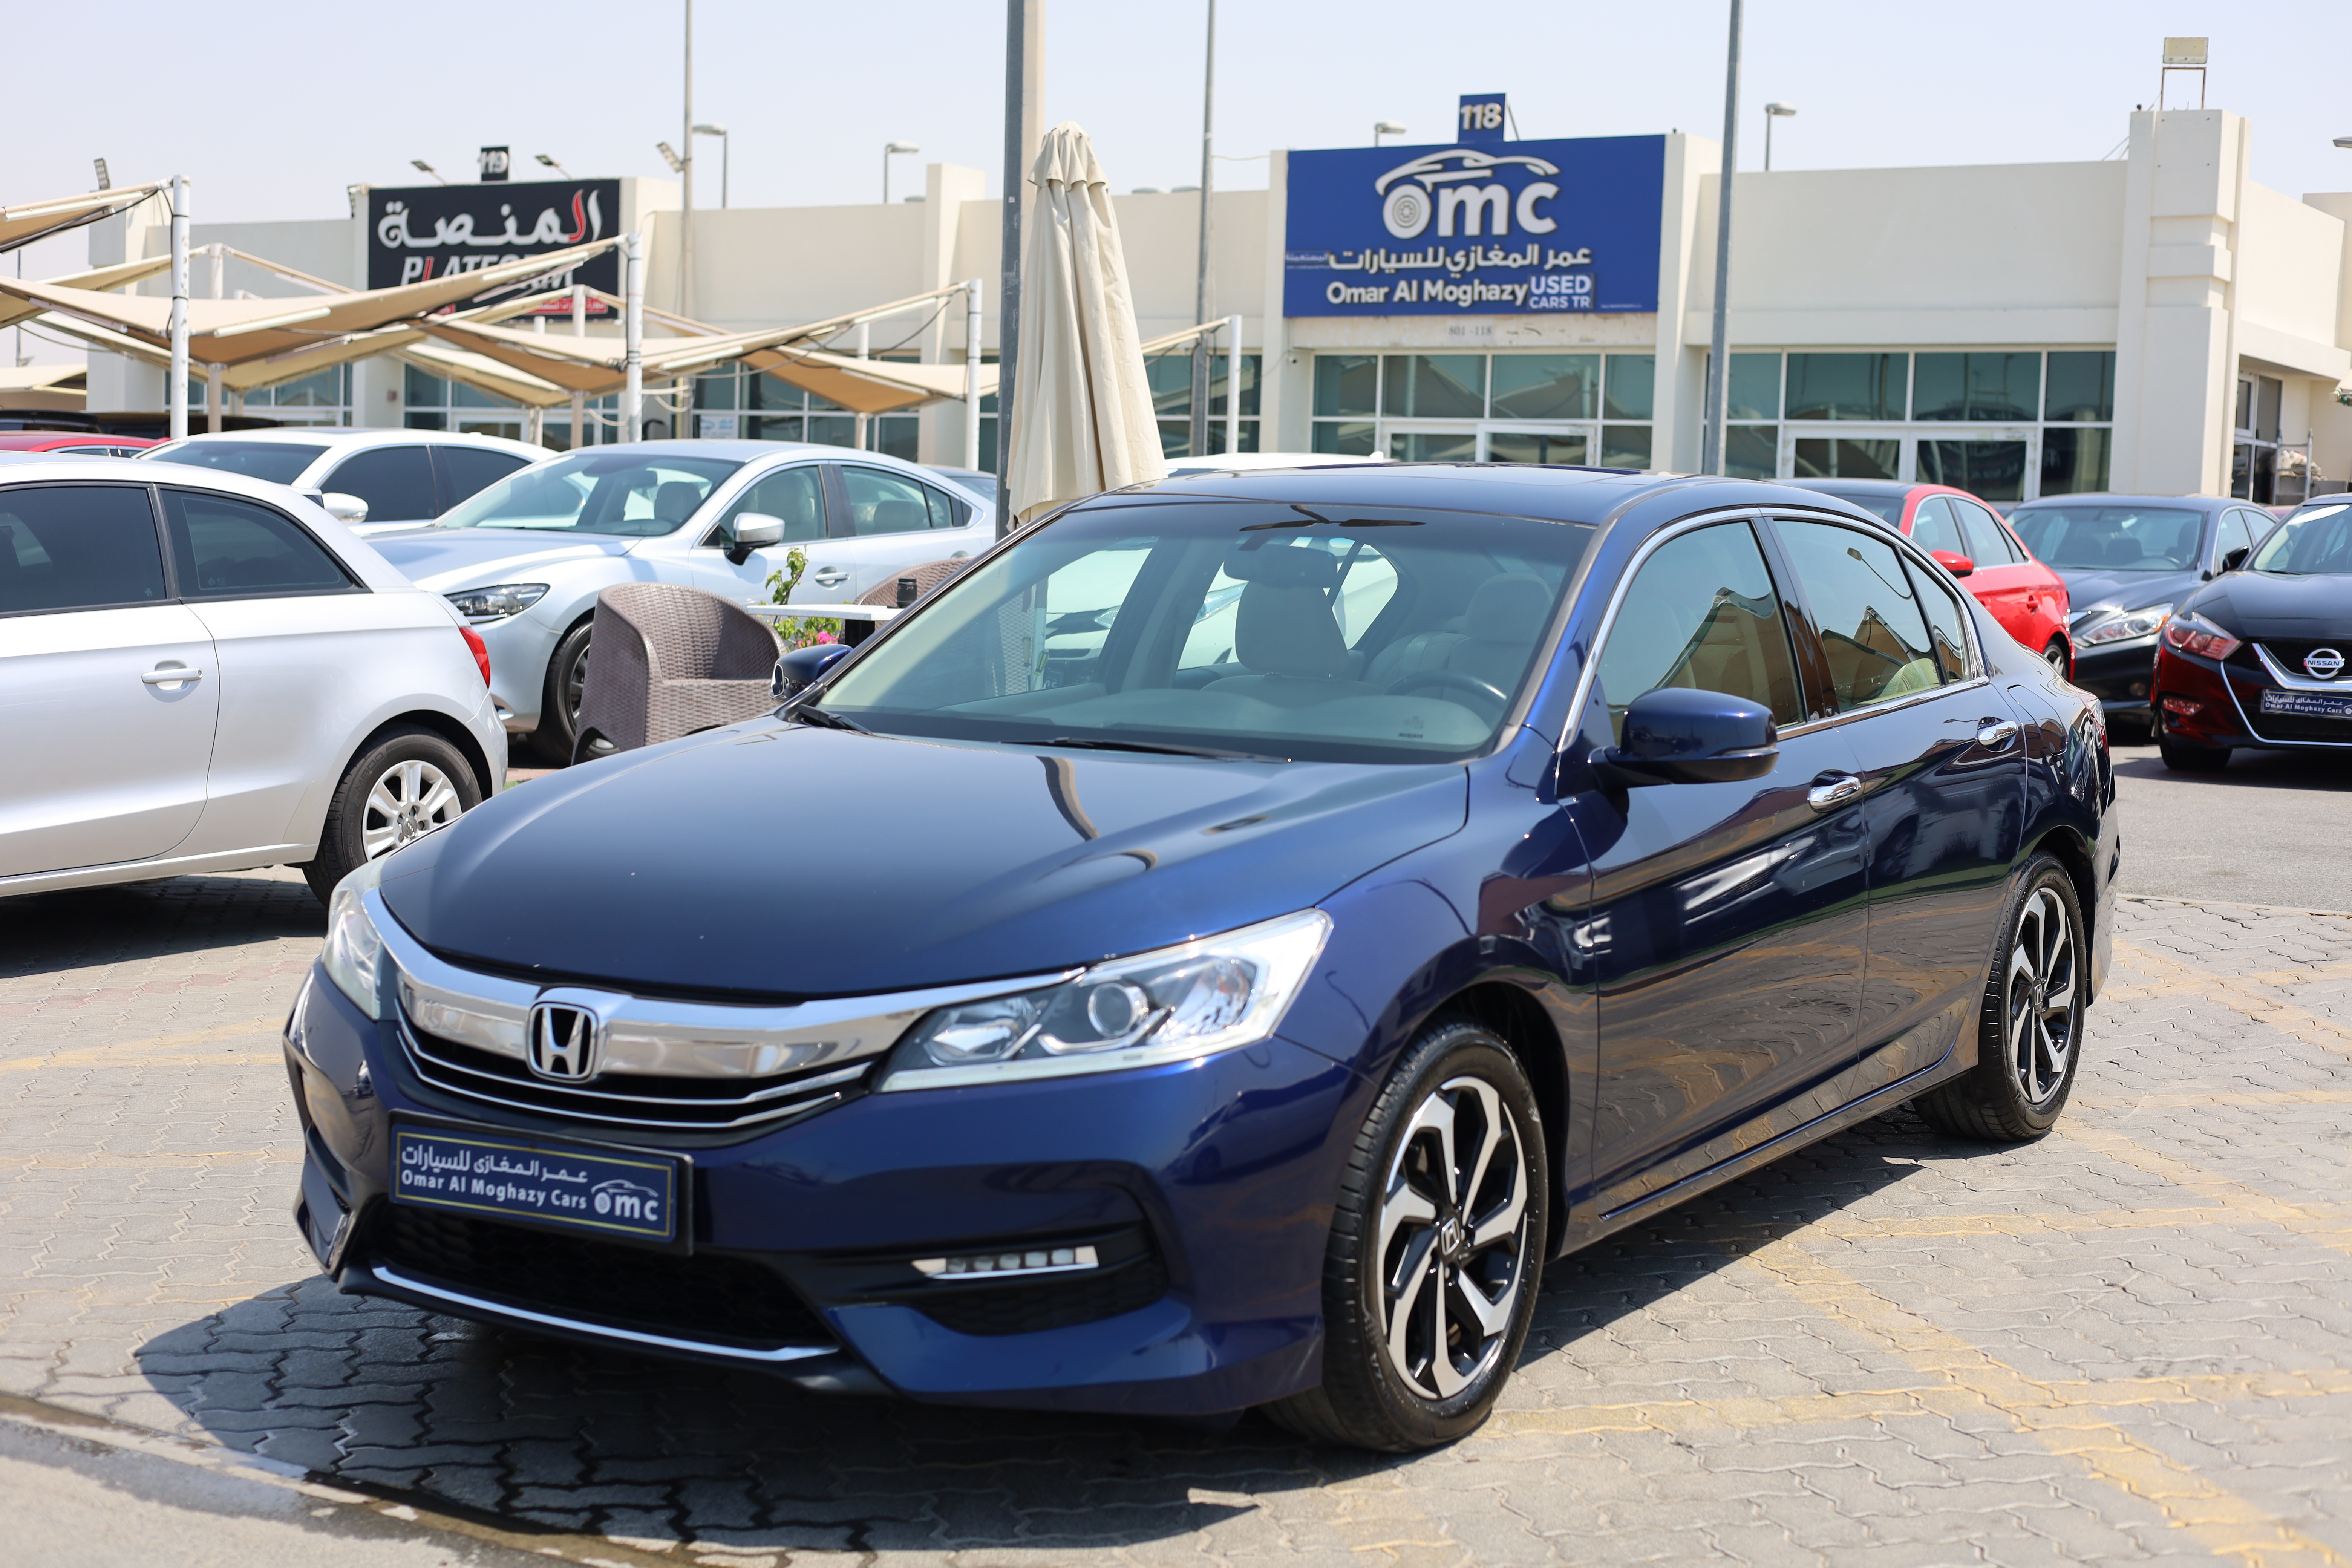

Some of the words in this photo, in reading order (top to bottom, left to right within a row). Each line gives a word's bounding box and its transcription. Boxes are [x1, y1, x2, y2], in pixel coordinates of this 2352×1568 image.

[1461, 102, 1502, 130] 118
[478, 150, 508, 173] 119
[378, 189, 602, 248] المنصة
[1329, 246, 1446, 274] للسيارات
[1445, 243, 1540, 278] المغازي
[1544, 247, 1592, 270] عمر
[1326, 281, 1390, 304] Omar
[1393, 279, 1419, 302] Al
[1423, 278, 1529, 307] Moghazy
[1530, 275, 1592, 295] USED
[1529, 296, 1568, 309] CARS
[1571, 296, 1591, 308] TR
[2265, 694, 2295, 704] للسيارات
[2294, 704, 2325, 713] Moghazy
[401, 1144, 471, 1173] للسيارات
[540, 1167, 588, 1183] عمر
[401, 1169, 444, 1189] Omar
[449, 1175, 466, 1192] Al
[471, 1178, 546, 1207] Moghazy
[550, 1189, 587, 1209] Cars
